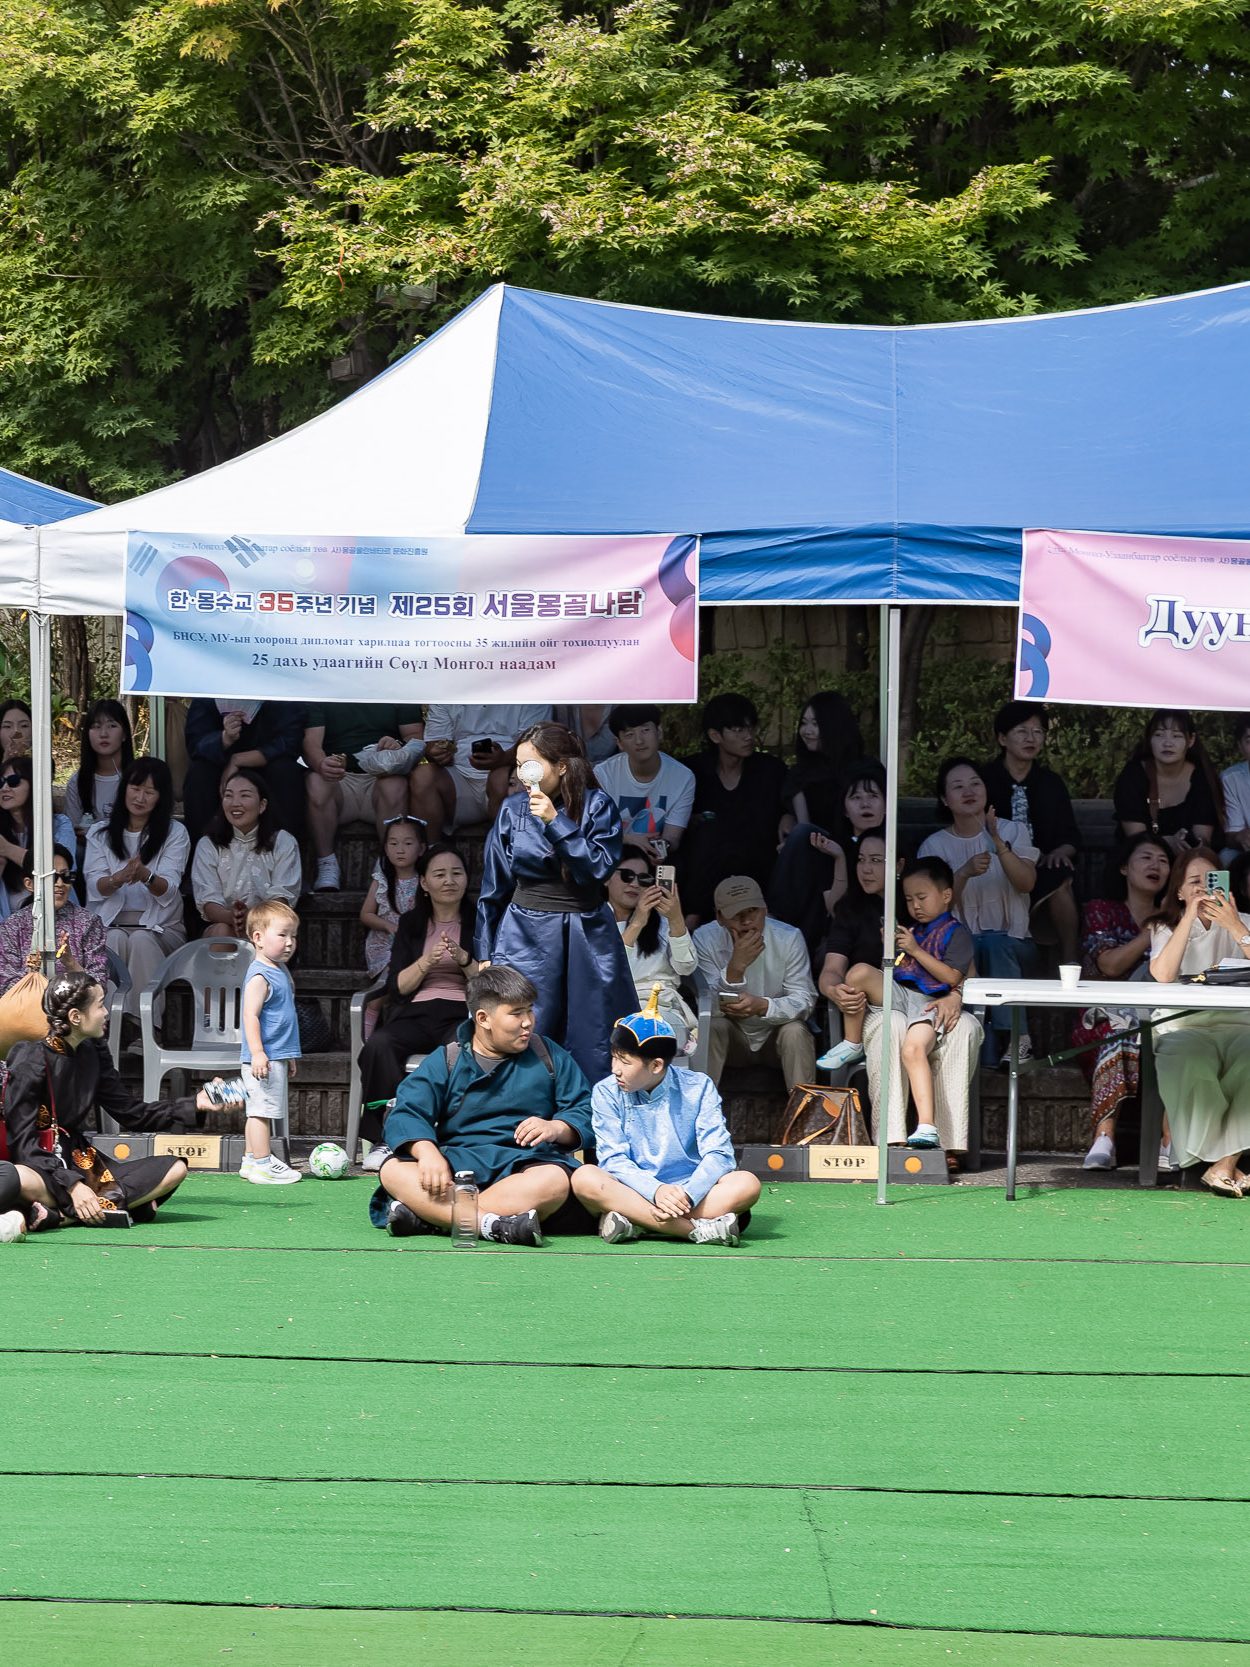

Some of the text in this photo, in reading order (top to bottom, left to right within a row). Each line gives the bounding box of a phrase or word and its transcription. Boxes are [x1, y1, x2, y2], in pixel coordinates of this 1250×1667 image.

[259, 592, 332, 614] 35주년
[338, 596, 375, 615] 기념
[391, 595, 473, 617] 제25회
[483, 590, 643, 618] 서울몽골나담
[173, 631, 640, 649] БНСУ, МУ-ын хооронд дипломат харилцаа тогтоосны 35 жилийн ойг тохиолдуулан
[252, 653, 556, 672] 25 дахь удаагийн Сөүл Монгол наадам
[167, 1146, 207, 1157] STOP
[822, 1157, 865, 1168] STOP
